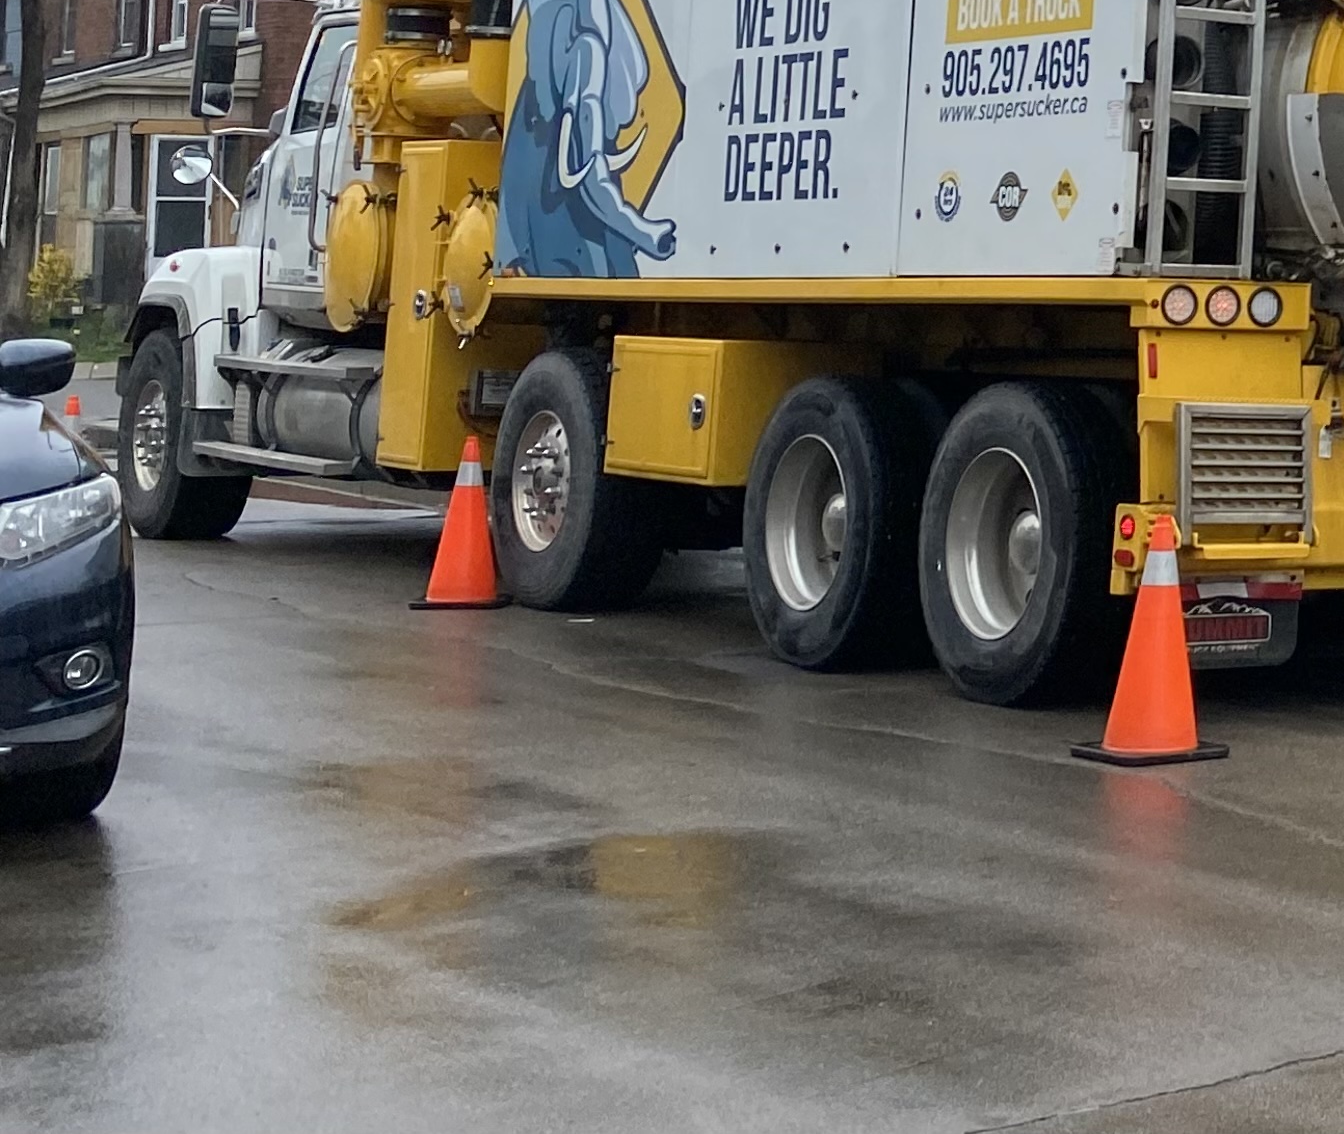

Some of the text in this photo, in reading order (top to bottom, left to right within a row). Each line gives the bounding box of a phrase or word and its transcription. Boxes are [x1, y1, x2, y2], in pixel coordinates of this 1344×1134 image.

[727, 48, 849, 125] A LITTLE
[942, 37, 1091, 98] 905.297.4695
[939, 94, 1088, 123] www.supersucker.ca
[724, 129, 838, 202] DEEPER.
[998, 185, 1020, 208] COR
